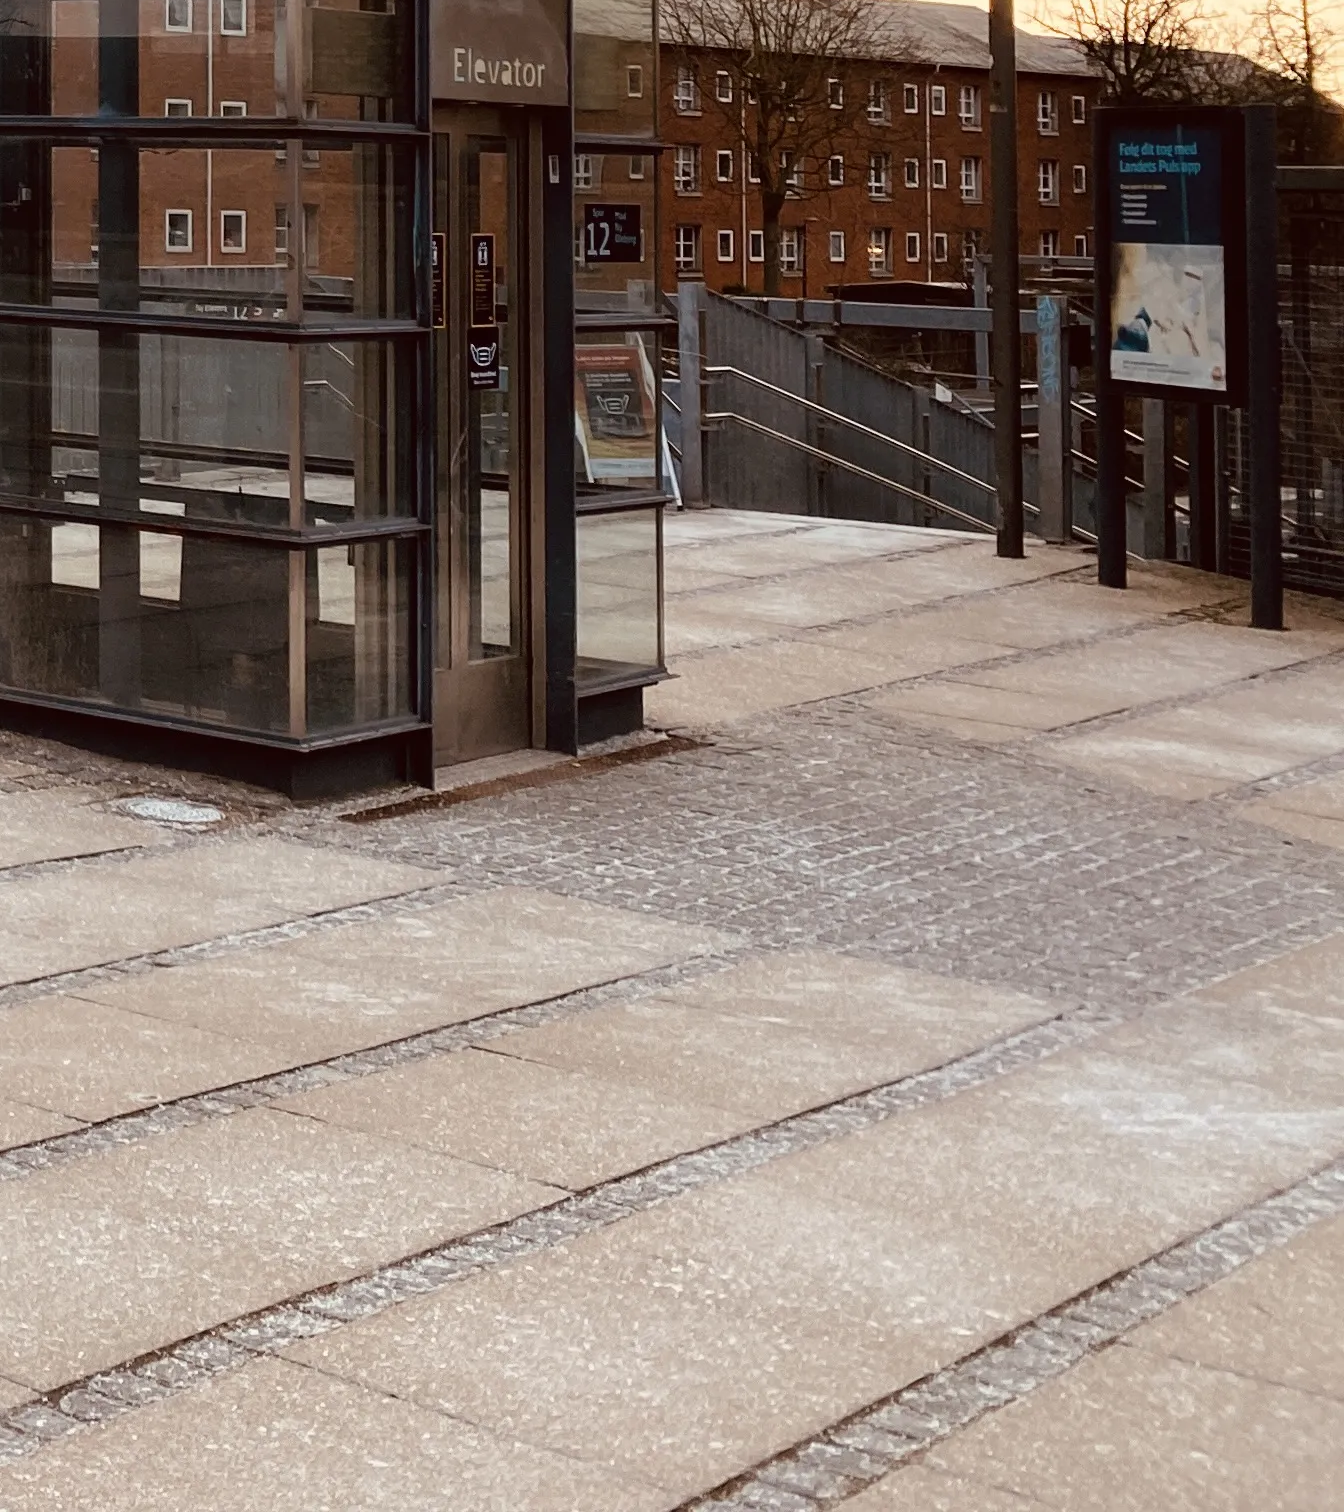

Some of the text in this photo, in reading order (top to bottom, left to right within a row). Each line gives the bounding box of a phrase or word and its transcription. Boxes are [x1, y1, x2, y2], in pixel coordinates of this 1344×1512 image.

[454, 47, 546, 88] Elevator
[1174, 142, 1198, 156] med
[587, 222, 611, 256] 12
